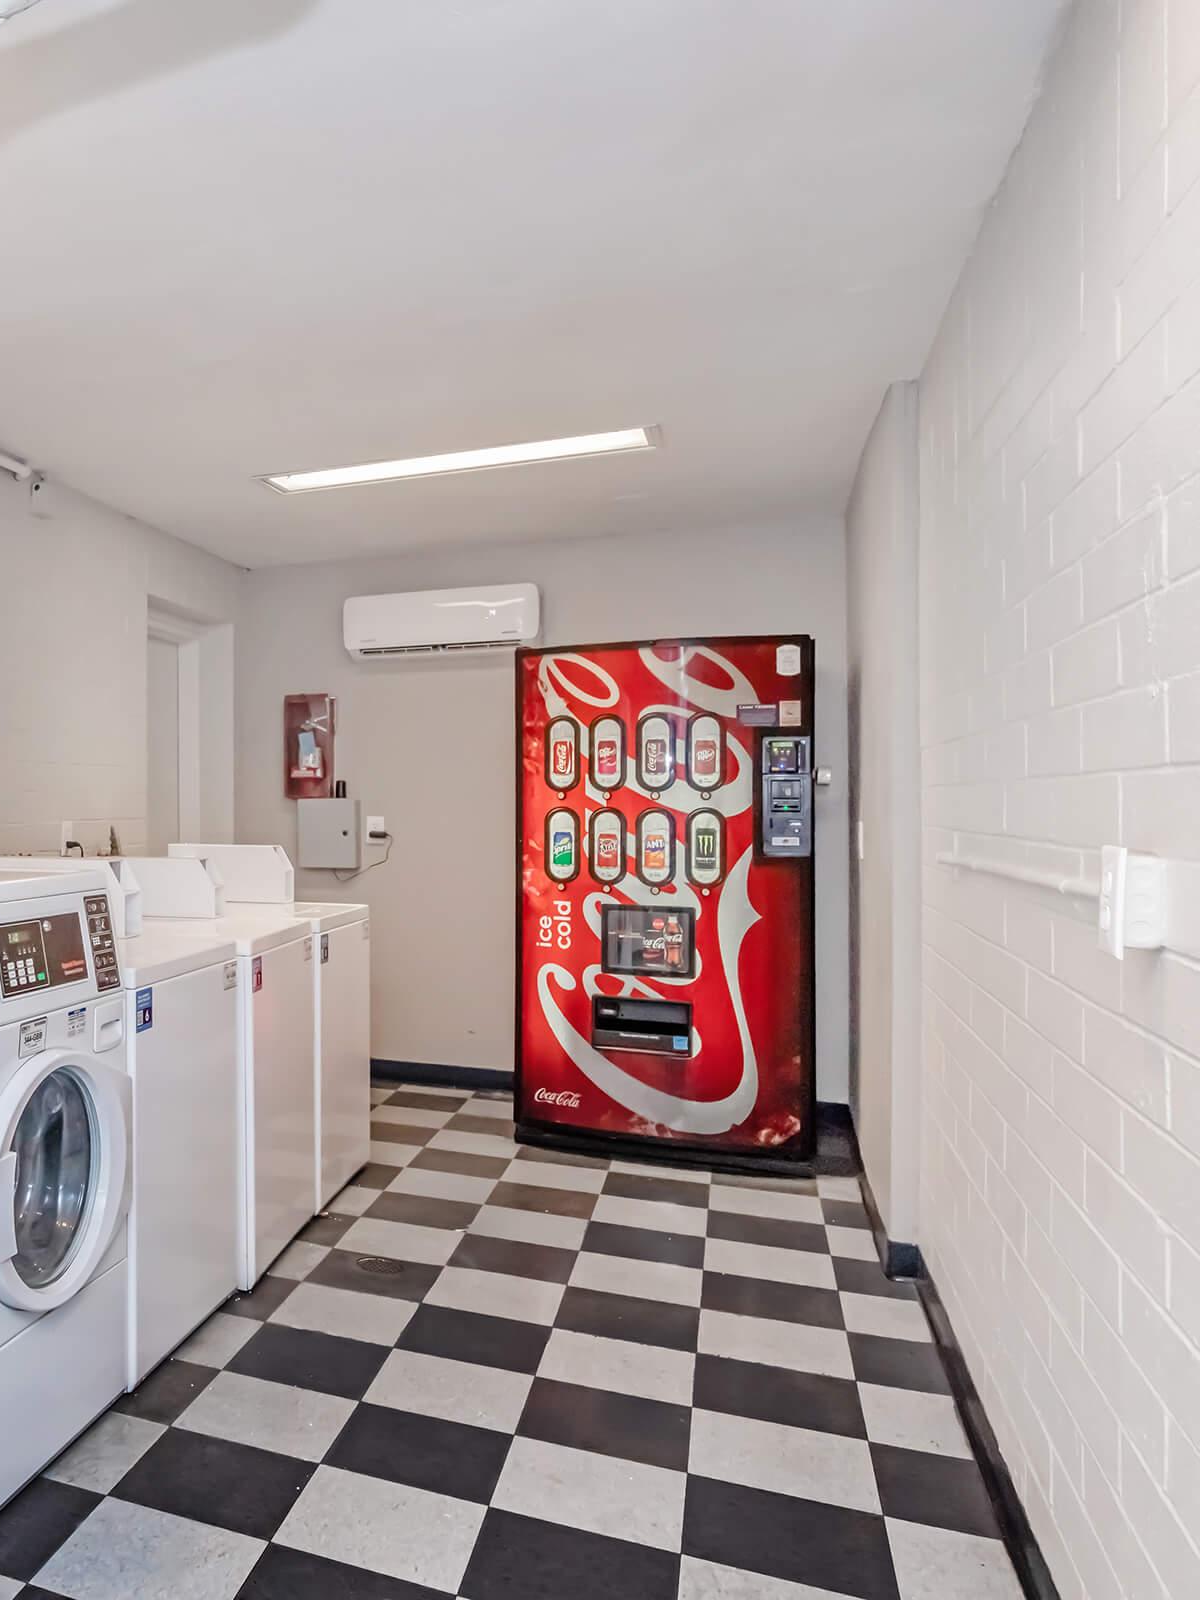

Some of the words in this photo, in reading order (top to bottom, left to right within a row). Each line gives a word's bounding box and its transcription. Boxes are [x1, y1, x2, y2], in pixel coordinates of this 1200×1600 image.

[536, 915, 553, 947] ice
[553, 900, 572, 950] cold
[145, 1009, 150, 1022] 6
[534, 1088, 581, 1108] Coca-Cola
